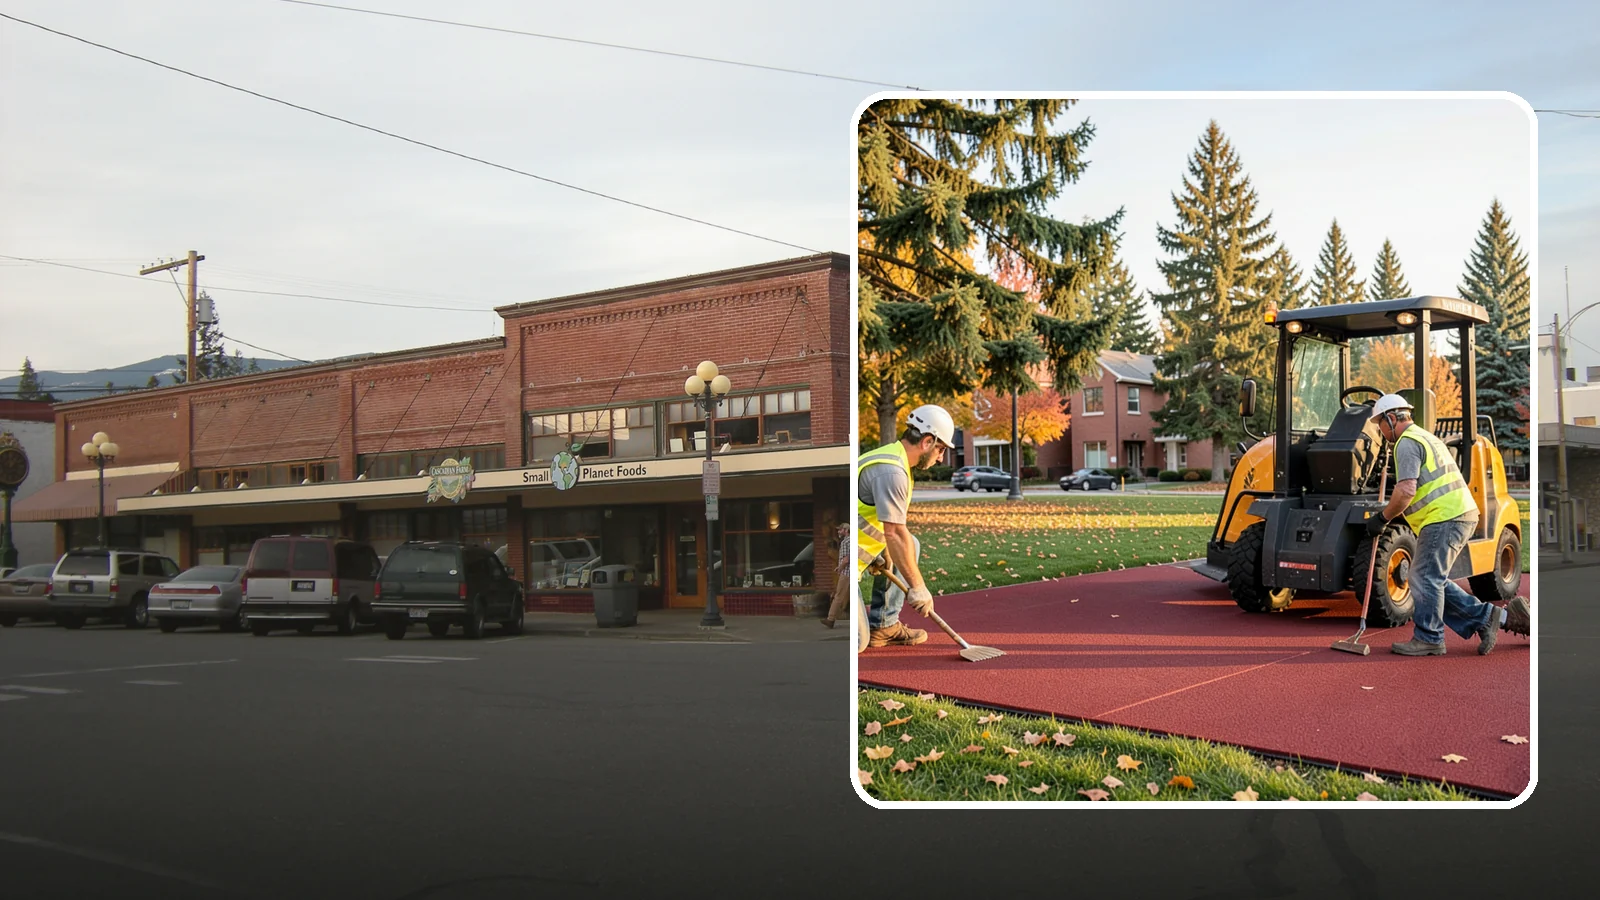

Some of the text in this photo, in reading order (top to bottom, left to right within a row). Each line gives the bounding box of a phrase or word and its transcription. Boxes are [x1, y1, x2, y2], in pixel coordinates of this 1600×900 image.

[523, 464, 647, 483] Small Planet Foods
